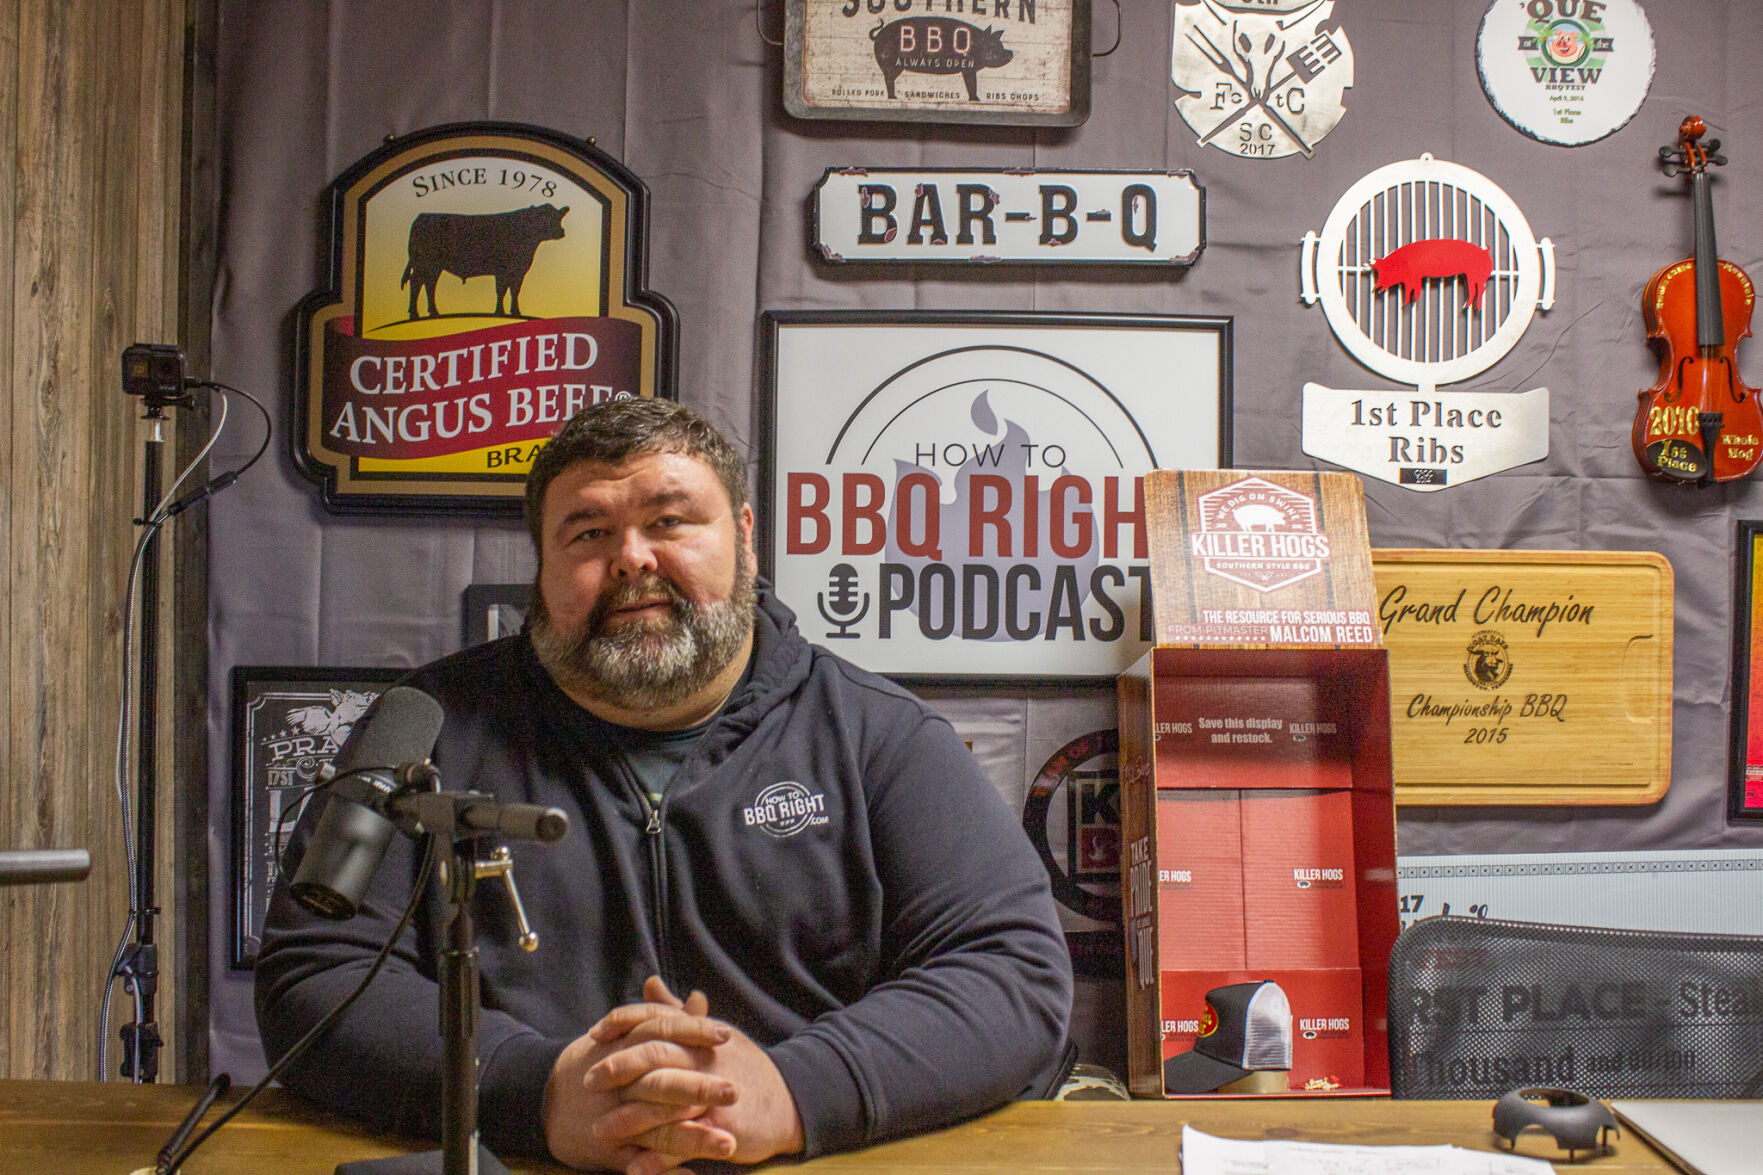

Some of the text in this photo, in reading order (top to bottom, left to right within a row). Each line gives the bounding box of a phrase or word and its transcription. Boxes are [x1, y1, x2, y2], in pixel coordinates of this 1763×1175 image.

[900, 26, 971, 56] BBQ
[895, 59, 975, 68] ALWAYS OPEN
[1530, 67, 1602, 84] VIEW
[904, 91, 960, 99] SANDWICHES
[1240, 143, 1276, 156] 2017
[412, 168, 557, 198] SINCE 1978
[857, 183, 1157, 252] BAR-B-Q
[350, 332, 599, 395] CERTIFIED
[329, 393, 493, 445] ANGUS
[1350, 399, 1503, 428] 1st Place
[1650, 406, 1699, 435] 2010
[486, 444, 541, 469] BRA
[916, 443, 1067, 468] HOW TO
[1388, 436, 1465, 464] Ribs
[1660, 440, 1688, 459] 1st
[1657, 456, 1697, 472] Place
[786, 472, 1149, 561] BBQ RIGH
[1227, 494, 1246, 507] DIG
[1249, 493, 1265, 501] ON
[1268, 495, 1300, 521] SWINE
[1191, 534, 1330, 558] KILLER HOGS
[1266, 562, 1290, 570] STYLE
[1203, 610, 1371, 625] THE RESOURCE FOR SERIOUS BBQ
[1379, 585, 1595, 638] Grand Champion
[1168, 625, 1373, 643] FROM PITMASTER MALCOM REED
[1406, 693, 1568, 726] Championship BBQ
[1155, 723, 1193, 733] LER HOGS
[1199, 717, 1283, 730] Save this display
[1289, 723, 1337, 733] KILLER HOGS
[1211, 733, 1272, 743] and restock.
[1464, 728, 1510, 744] 2015
[268, 736, 340, 762] PRA
[765, 790, 799, 804] HOW TO
[744, 804, 777, 825] BBQ
[778, 793, 824, 818] RIGHT
[1130, 836, 1149, 867] TAKE
[1159, 870, 1192, 882] ER HOGS
[1293, 868, 1343, 880] KILLER HOGS
[1409, 986, 1487, 1024] RST
[1502, 982, 1646, 1024] PLACE
[1161, 1020, 1198, 1032] LER HOGS
[1299, 1018, 1349, 1031] KILLER HOGS
